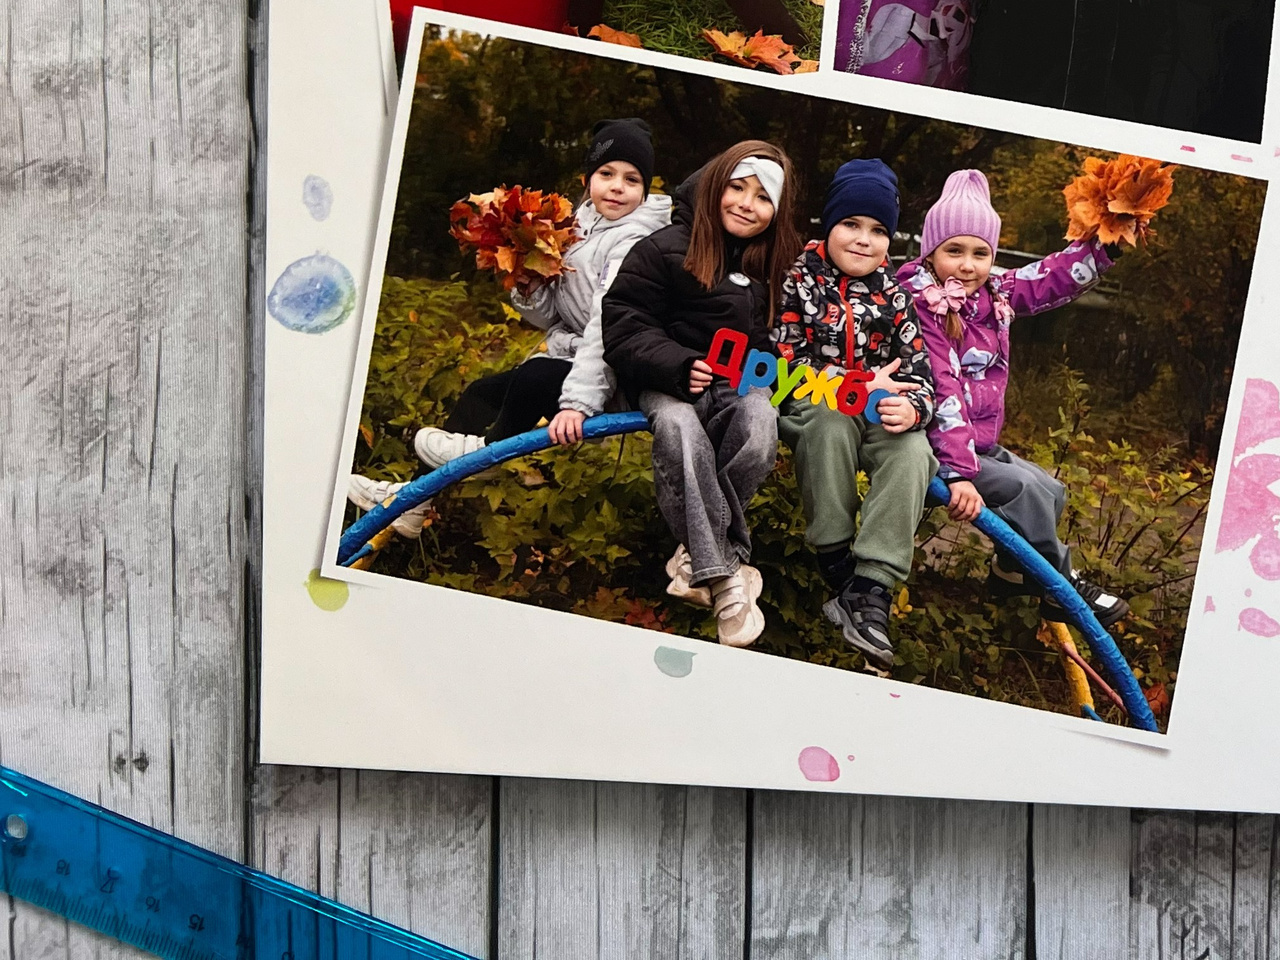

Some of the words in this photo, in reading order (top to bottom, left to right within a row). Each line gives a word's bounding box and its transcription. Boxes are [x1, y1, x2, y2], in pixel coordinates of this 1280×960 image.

[56, 859, 70, 876] 18
[145, 896, 160, 913] 16
[188, 913, 205, 932] 15
